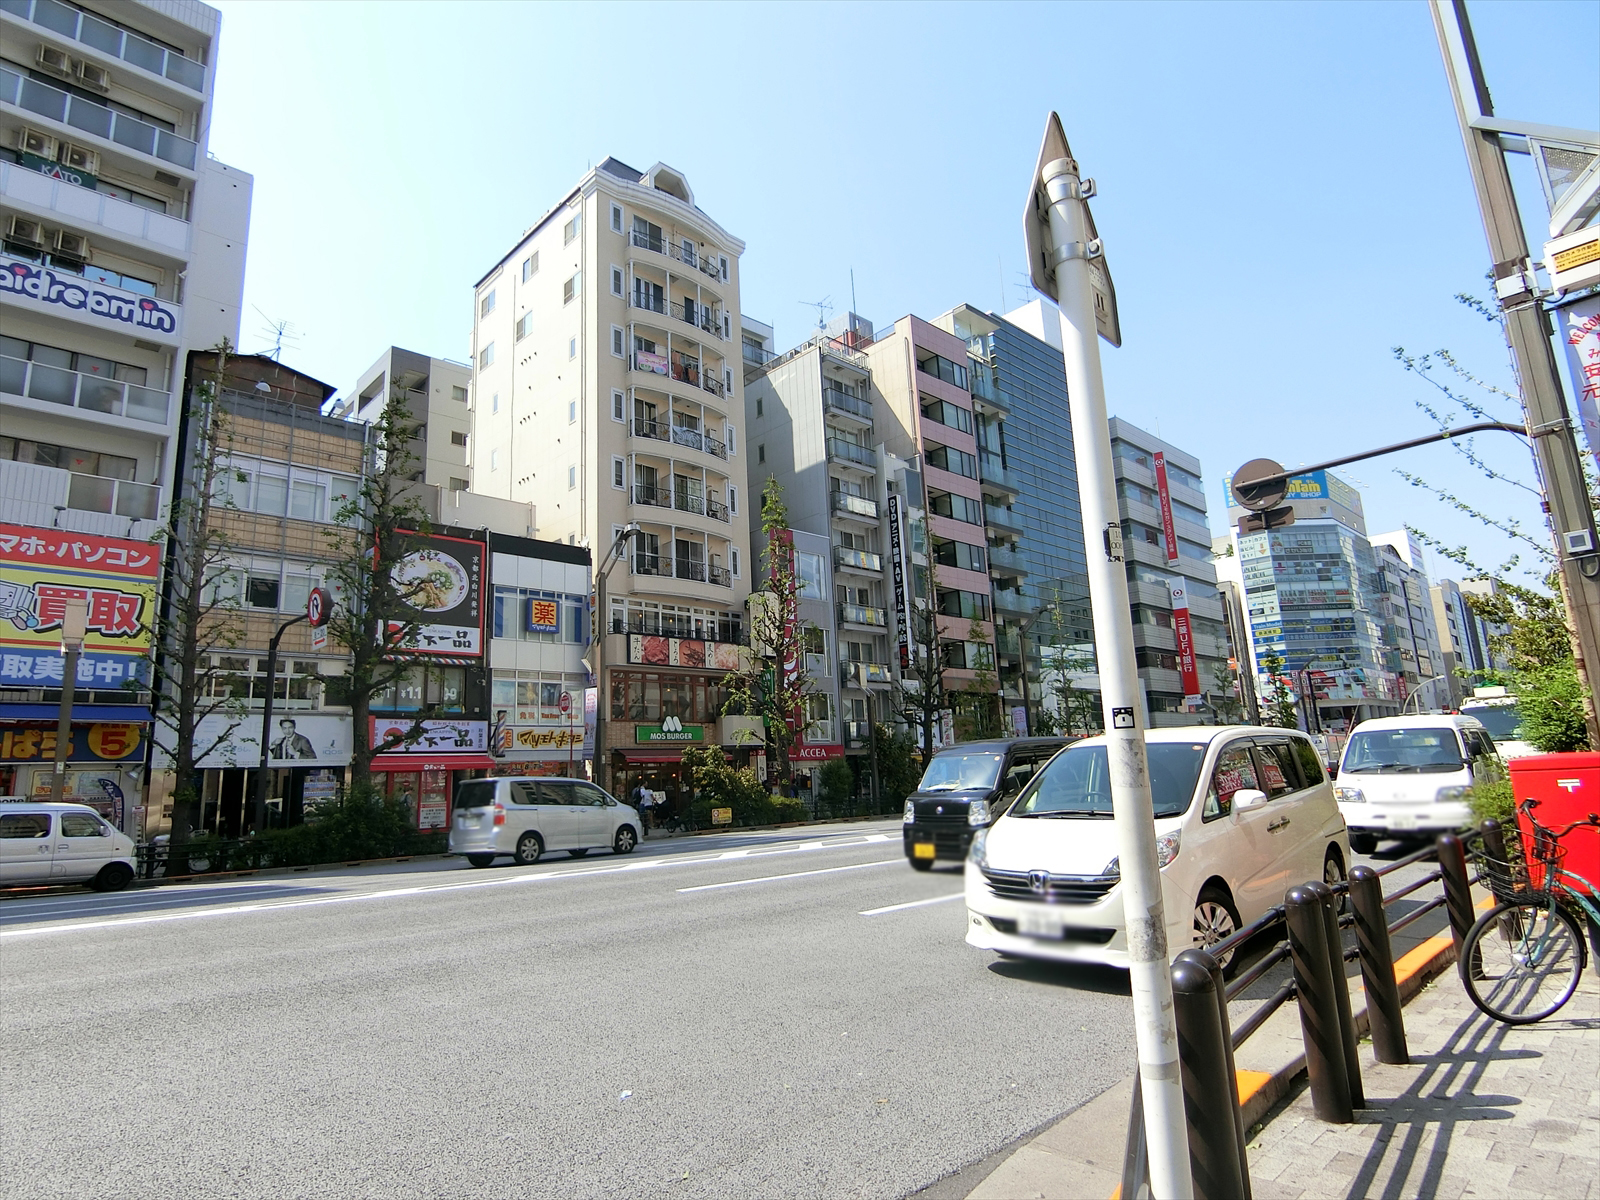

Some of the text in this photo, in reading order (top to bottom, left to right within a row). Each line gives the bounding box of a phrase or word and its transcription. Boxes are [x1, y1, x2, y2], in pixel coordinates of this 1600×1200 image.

[41, 164, 82, 186] KATO
[889, 499, 897, 521] DVD
[0, 534, 151, 567] マホ・パソコン
[471, 555, 479, 617] 京都北白川発祥
[37, 585, 140, 634] 買取
[535, 601, 555, 624] 薬
[633, 637, 641, 660] 牛たん
[1178, 617, 1192, 672] 三菱UFJ銀行
[100, 731, 126, 756] 5
[666, 732, 692, 740] BURGER
[800, 748, 827, 757] ACCEA
